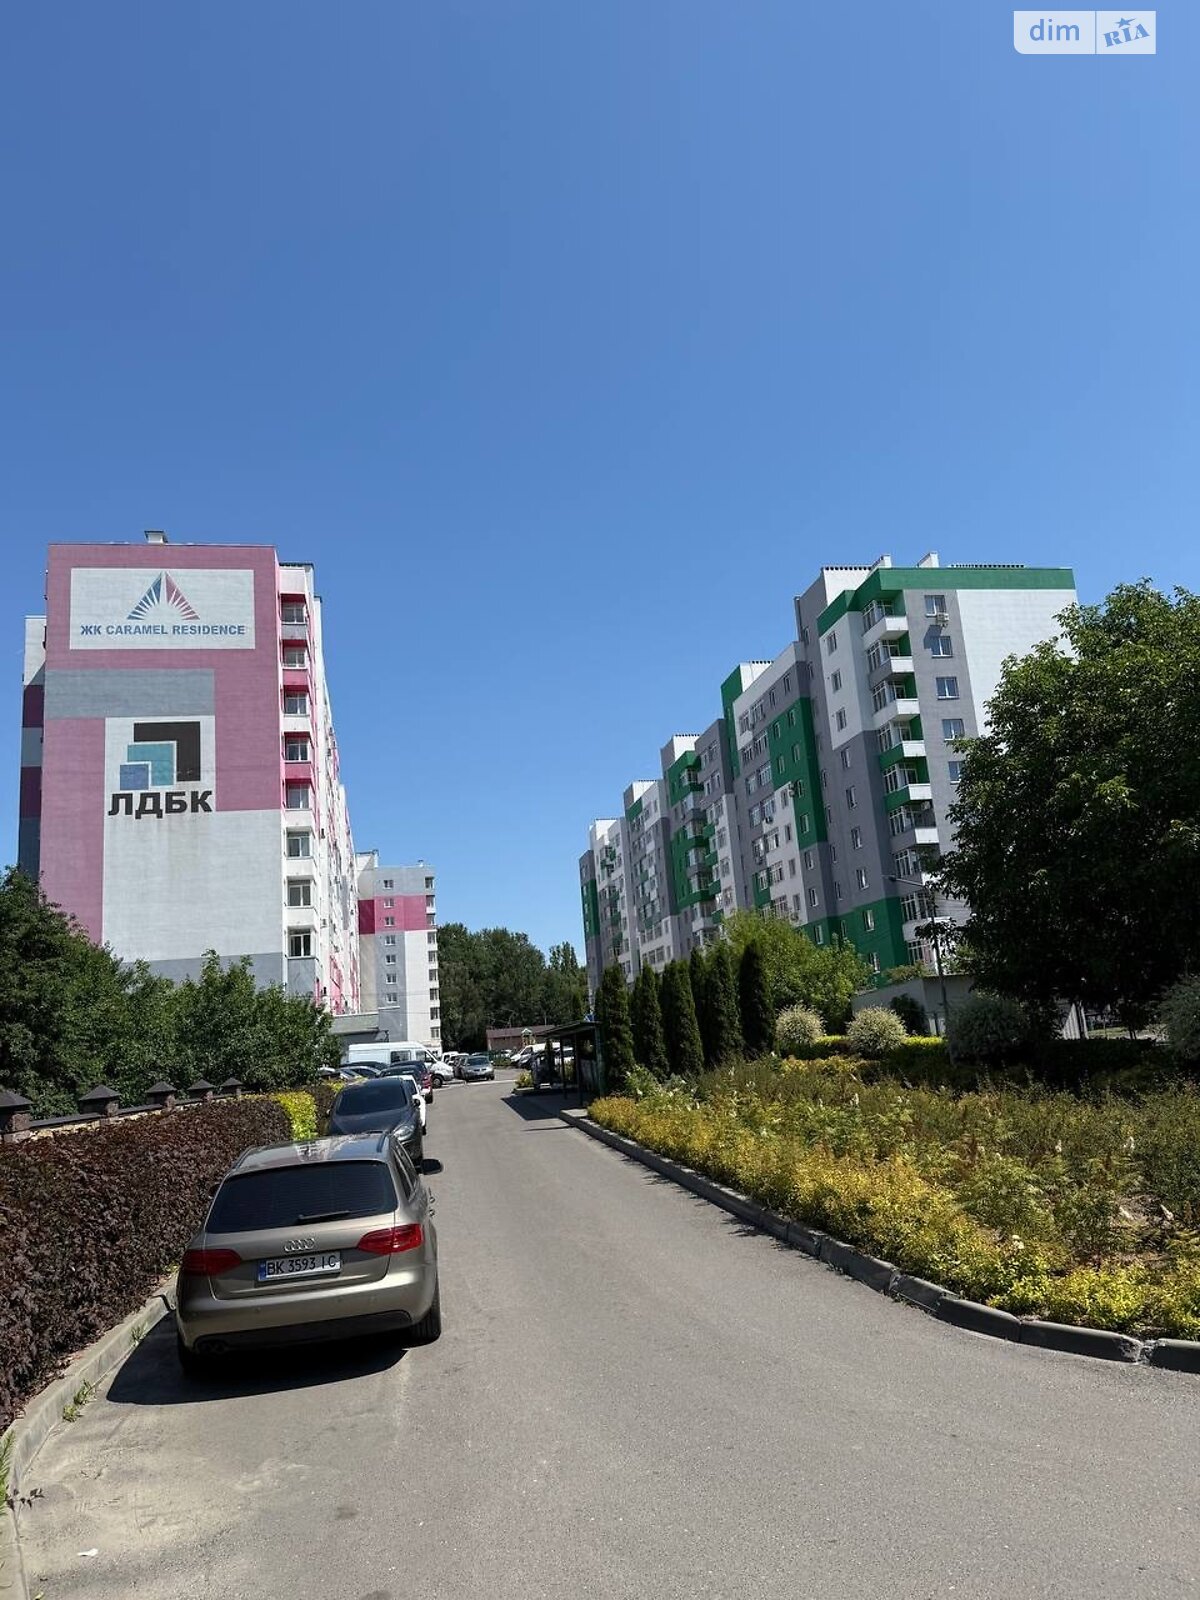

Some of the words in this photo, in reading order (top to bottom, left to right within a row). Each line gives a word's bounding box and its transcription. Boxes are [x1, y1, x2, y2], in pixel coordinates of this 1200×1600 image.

[80, 625, 101, 636] ЖК
[106, 625, 168, 635] CARAMEL
[172, 624, 246, 635] RESIDENCE
[108, 790, 213, 819] ЛДБК
[288, 1257, 316, 1273] 3593
